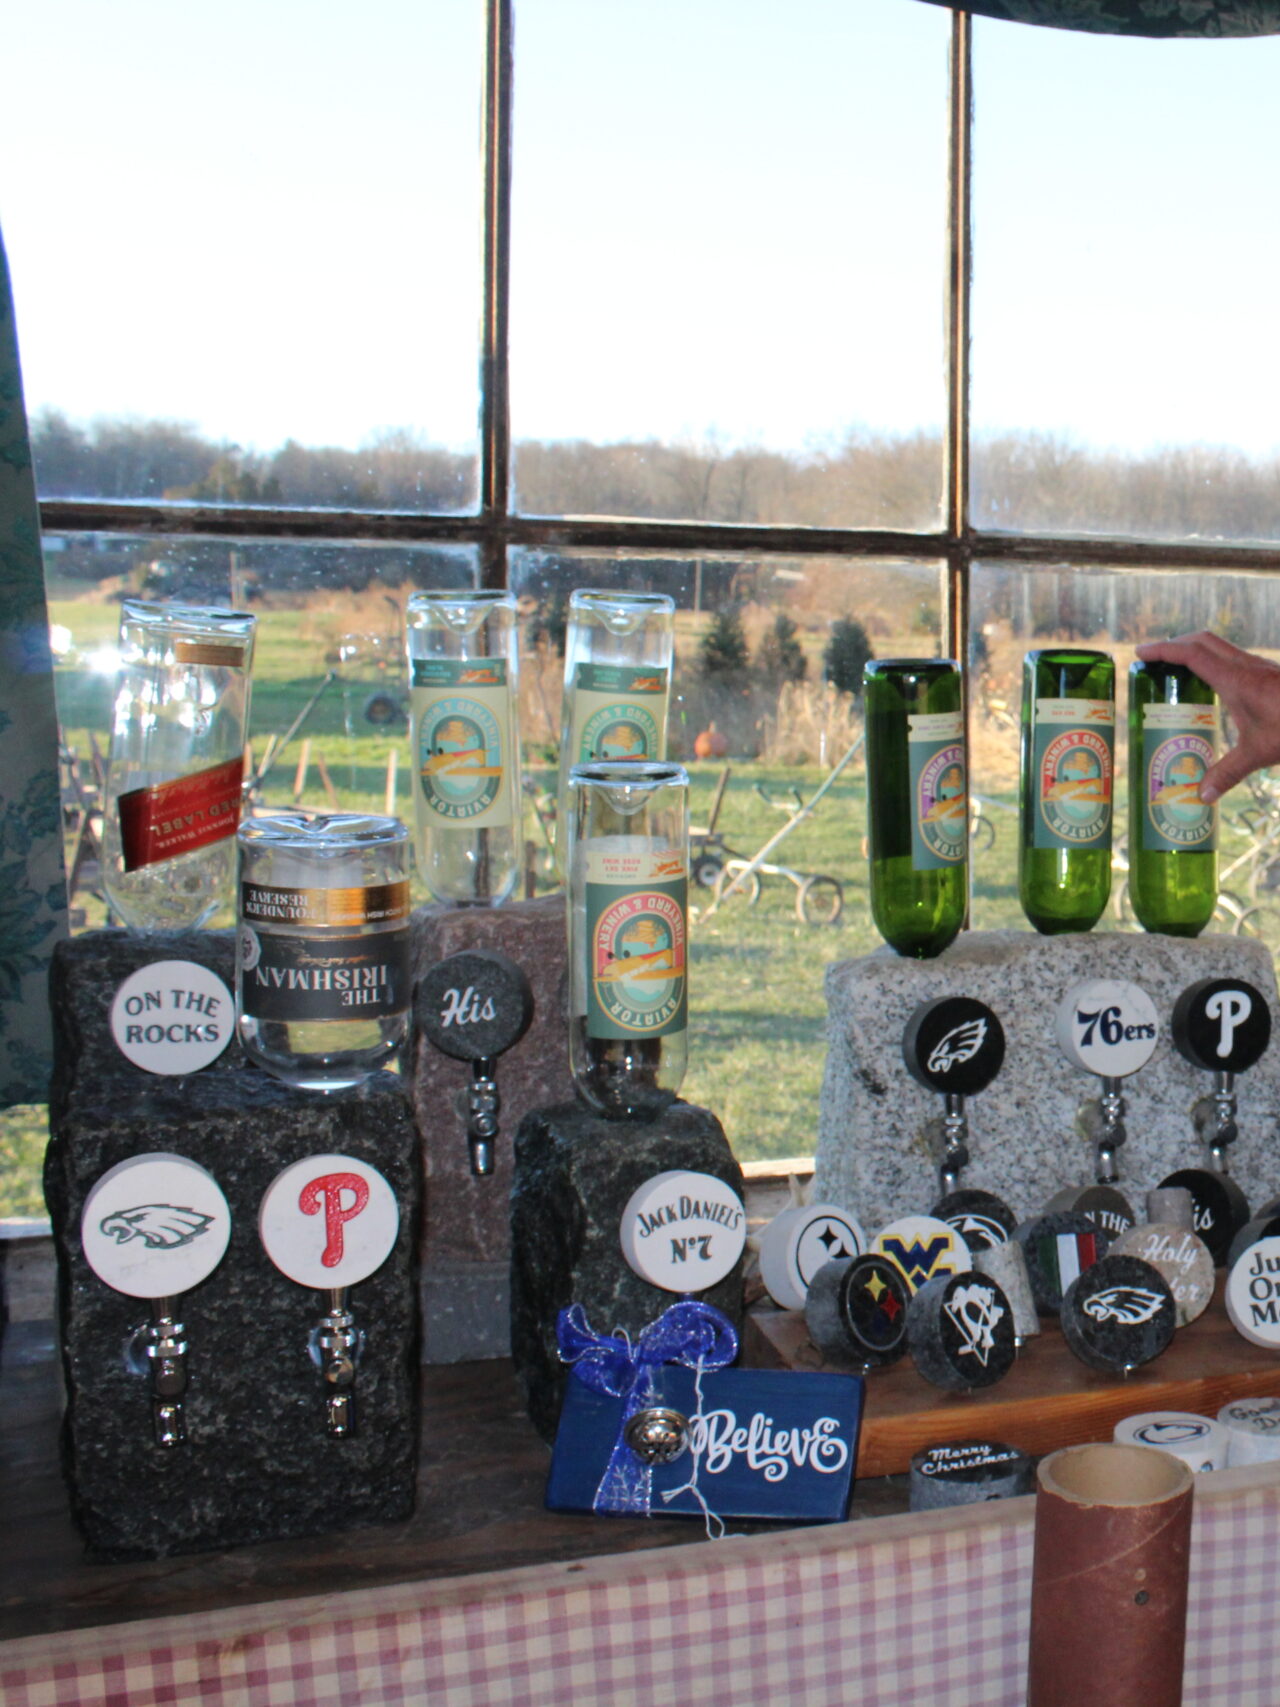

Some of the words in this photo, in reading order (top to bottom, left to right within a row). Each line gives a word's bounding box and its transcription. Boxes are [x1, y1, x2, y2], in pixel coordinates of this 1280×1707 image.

[208, 797, 240, 818] RED
[430, 794, 491, 818] AVIATOR
[150, 809, 206, 837] LABEL
[1053, 818, 1104, 838] AVIATOR
[1160, 821, 1211, 840] AVIATOR
[934, 839, 965, 859] ATOR
[249, 889, 308, 907] RESERVE
[599, 902, 632, 950] WINERY
[647, 897, 684, 945] VINEYARD
[256, 965, 388, 991] IRISHMAN
[125, 990, 162, 1016] ON
[170, 989, 221, 1018] THE
[341, 989, 381, 1006] THE
[440, 986, 497, 1028] His
[610, 999, 677, 1026] AVIATOR
[1205, 990, 1252, 1058] P
[126, 1023, 220, 1044] ROCKS
[1076, 1005, 1156, 1048] 76ers
[299, 1172, 370, 1268] P
[1192, 1203, 1215, 1231] is
[1138, 1232, 1198, 1274] Holy
[921, 1449, 1020, 1475] Christmas
[928, 1443, 992, 1462] Merry
